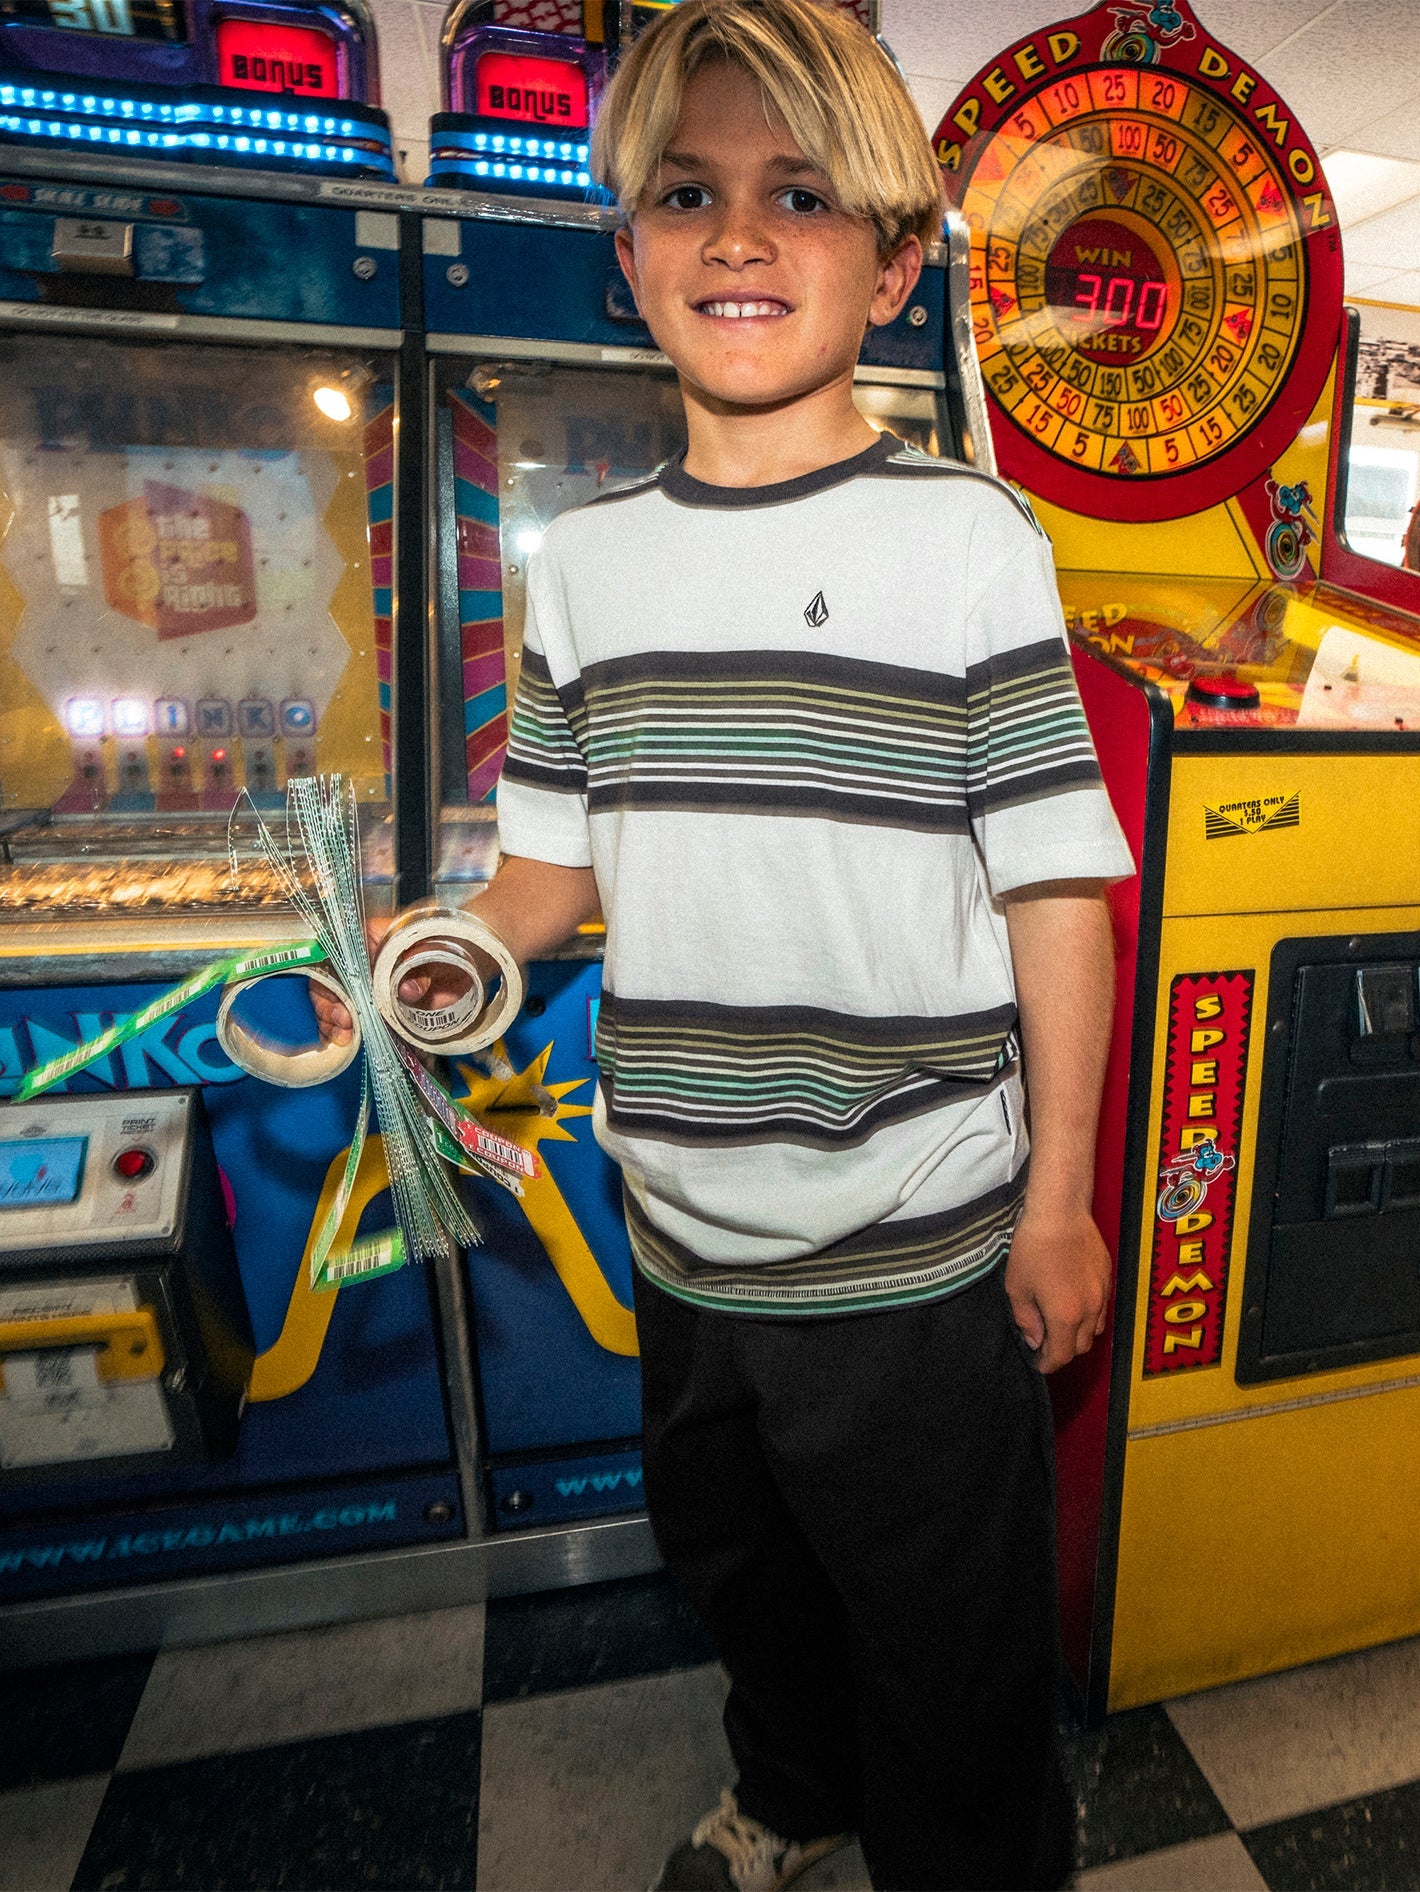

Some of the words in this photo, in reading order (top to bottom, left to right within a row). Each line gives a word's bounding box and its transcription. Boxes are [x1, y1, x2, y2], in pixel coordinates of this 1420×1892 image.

[937, 31, 1080, 171] SPEED
[1055, 82, 1080, 114] 10
[1103, 75, 1126, 101] 25
[1152, 81, 1175, 107] 20
[1014, 111, 1036, 140] 5
[1193, 102, 1220, 135] 15
[1118, 125, 1141, 151] 100
[1153, 134, 1177, 164] 50
[1199, 47, 1330, 229] DEMON
[1232, 143, 1255, 167] 5
[1143, 184, 1165, 213] 25
[1208, 189, 1234, 218] 25
[1075, 245, 1133, 269] WIN
[1233, 273, 1254, 297] 25
[1071, 274, 1168, 330] 300
[1270, 294, 1292, 320] 10
[1179, 319, 1202, 346] 75
[1159, 347, 1184, 378] 100
[1210, 344, 1235, 374] 20
[1257, 342, 1281, 371] 20
[990, 366, 1019, 395] 25
[1026, 363, 1053, 393] 25
[1068, 364, 1092, 388] 50
[1101, 372, 1122, 396] 150
[1132, 366, 1155, 394] 50
[1187, 373, 1212, 404] 25
[1056, 386, 1082, 416] 50
[1160, 394, 1183, 422] 50
[1233, 383, 1257, 414] 25
[1026, 404, 1054, 433] 15
[1092, 402, 1115, 430] 75
[1127, 406, 1149, 431] 100
[1072, 432, 1090, 457] 5
[1199, 416, 1222, 447] 15
[1164, 438, 1179, 463] 5
[1218, 800, 1261, 814] QUARTERS
[1263, 795, 1285, 807] ONLY
[1246, 814, 1266, 825] PLAY
[415, 1009, 447, 1018] ONE
[1180, 994, 1226, 1153] SPEED
[120, 1123, 156, 1132] TICKET
[121, 1117, 156, 1126] PRINT
[474, 1126, 521, 1153] COUPON
[476, 1147, 524, 1173] COUPON
[1161, 1211, 1214, 1355] DEMON
